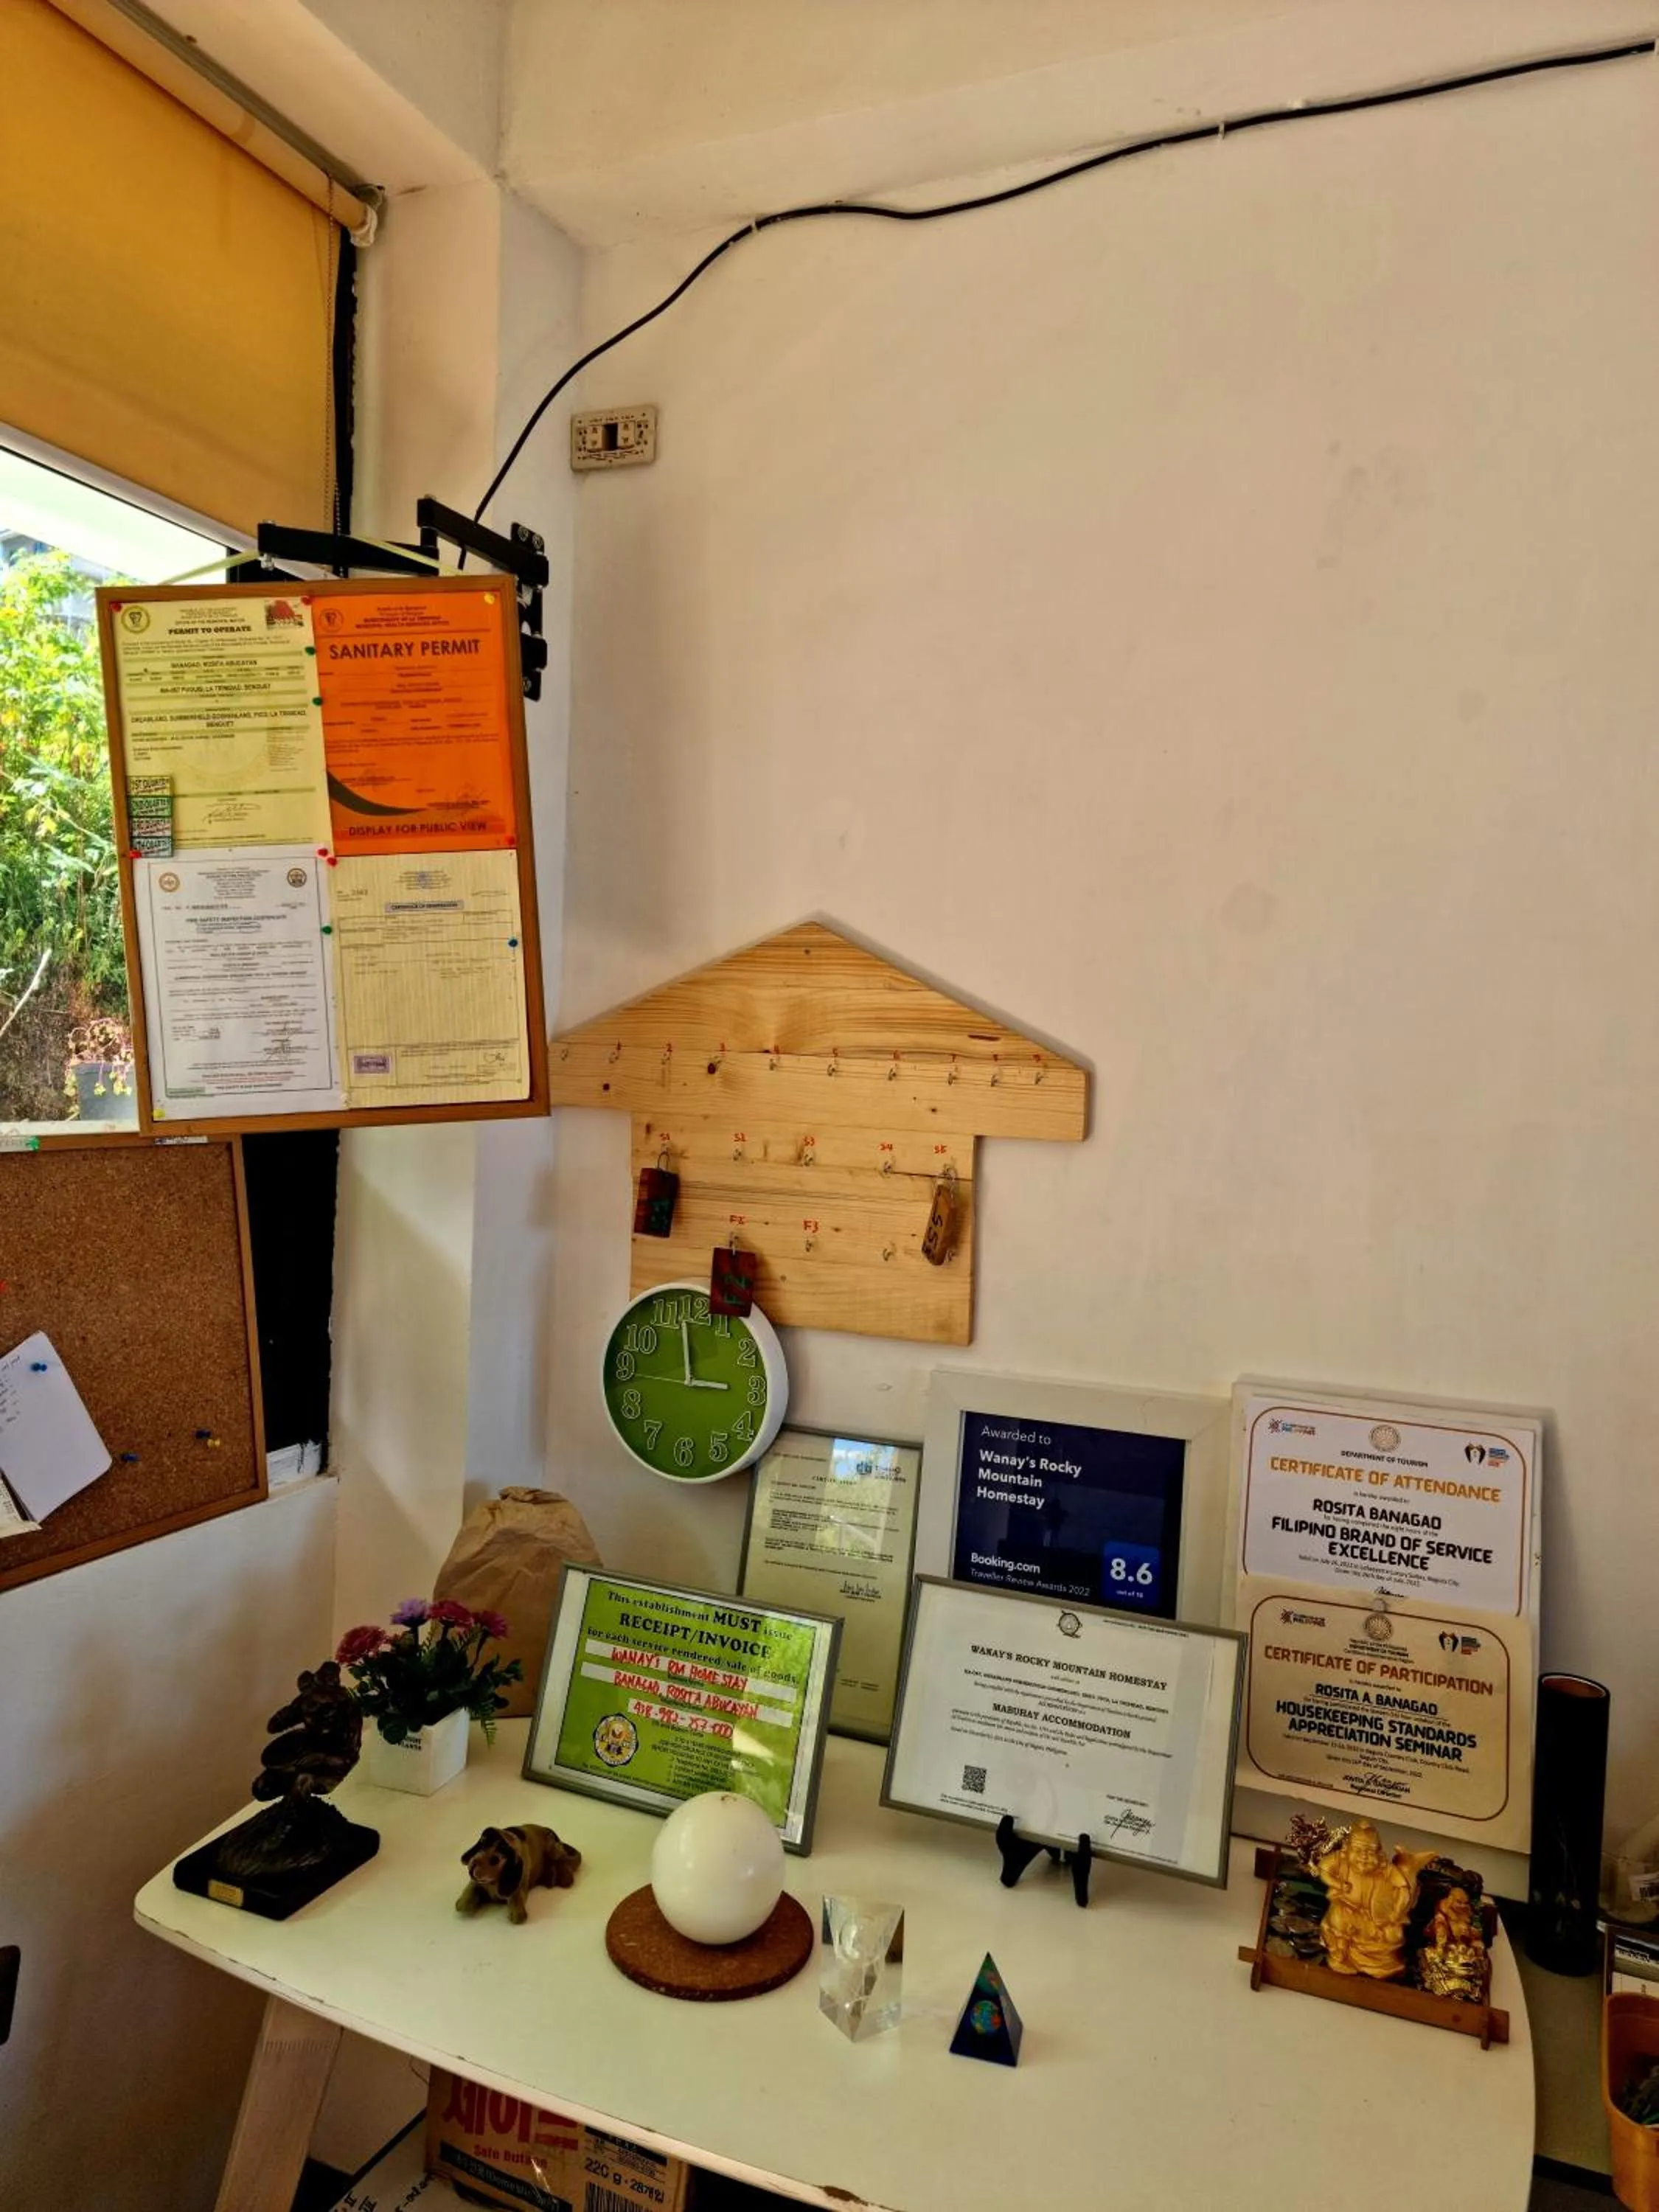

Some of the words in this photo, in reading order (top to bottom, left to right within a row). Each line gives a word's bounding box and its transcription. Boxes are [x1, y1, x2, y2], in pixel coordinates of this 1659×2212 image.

[330, 641, 414, 660] SANITARY
[421, 639, 480, 656] PERMIT
[349, 826, 392, 836] DISPLAY
[396, 824, 415, 834] FOR
[420, 822, 456, 833] PUBLIC
[460, 821, 487, 831] VIEW
[804, 1220, 818, 1234] F3
[651, 1299, 679, 1329] 11
[679, 1295, 711, 1326] 12
[625, 1324, 657, 1354] 10
[715, 1314, 731, 1338] 1
[616, 1351, 635, 1380] 9
[737, 1338, 757, 1368] 2
[622, 1388, 641, 1419] 8
[748, 1375, 767, 1406] 3
[644, 1419, 662, 1450] 7
[731, 1411, 754, 1441] 4
[981, 1426, 1036, 1444] Awarded
[1039, 1434, 1051, 1445] to
[673, 1437, 694, 1467] 6
[709, 1431, 728, 1462] 5
[1340, 1450, 1385, 1462] DEPARTMENT
[1397, 1457, 1428, 1467] TOURISM
[978, 1468, 1042, 1487] Mountain
[979, 1450, 1036, 1470] Wanay's
[1040, 1459, 1082, 1478] Rocky
[1270, 1456, 1364, 1483] CERTIFICATE
[1368, 1470, 1390, 1486] OF
[1394, 1475, 1501, 1503] ATTENDANCE
[977, 1486, 1045, 1510] Homestay
[1312, 1498, 1365, 1518] ROSITA
[1369, 1506, 1441, 1530] BANAGAO
[1272, 1516, 1335, 1539] FILIPINO
[1340, 1527, 1396, 1548] BRAND
[1401, 1536, 1422, 1551] OF
[1426, 1540, 1493, 1564] SERVICE
[971, 1552, 1040, 1574] Booking.com
[1110, 1558, 1153, 1585] 8.6
[1329, 1542, 1430, 1571] EXCELLENCE
[1036, 1580, 1067, 1593] Awards
[1068, 1586, 1091, 1597] 2022
[608, 1591, 630, 1604] This
[633, 1599, 709, 1621] establishment
[713, 1610, 762, 1633] MUST
[763, 1627, 793, 1641] issue
[619, 1613, 771, 1658] RECEIPT/INVOICE
[605, 1632, 629, 1644] each
[633, 1638, 669, 1652] service
[749, 1665, 760, 1674] of
[971, 1645, 1012, 1660] WANAY'S
[1015, 1654, 1051, 1668] ROCKY
[1053, 1660, 1106, 1679] MOUNTAIN
[1109, 1672, 1167, 1691] HOMESTAY
[1265, 1645, 1352, 1672] CERTIFICATE
[1356, 1660, 1376, 1674] OF
[1380, 1665, 1493, 1695] PARTICIPATION
[1315, 1683, 1359, 1701] ROSITA
[1376, 1694, 1438, 1716] BANAGAO
[1042, 1714, 1131, 1739] ACCOMMODATION
[1276, 1700, 1384, 1731] HOUSEKEEPING
[1388, 1719, 1477, 1748] STANDARDS
[1288, 1718, 1391, 1747] APPRECIATION
[1395, 1736, 1462, 1762] SEMINAR
[585, 2157, 608, 2178] 220
